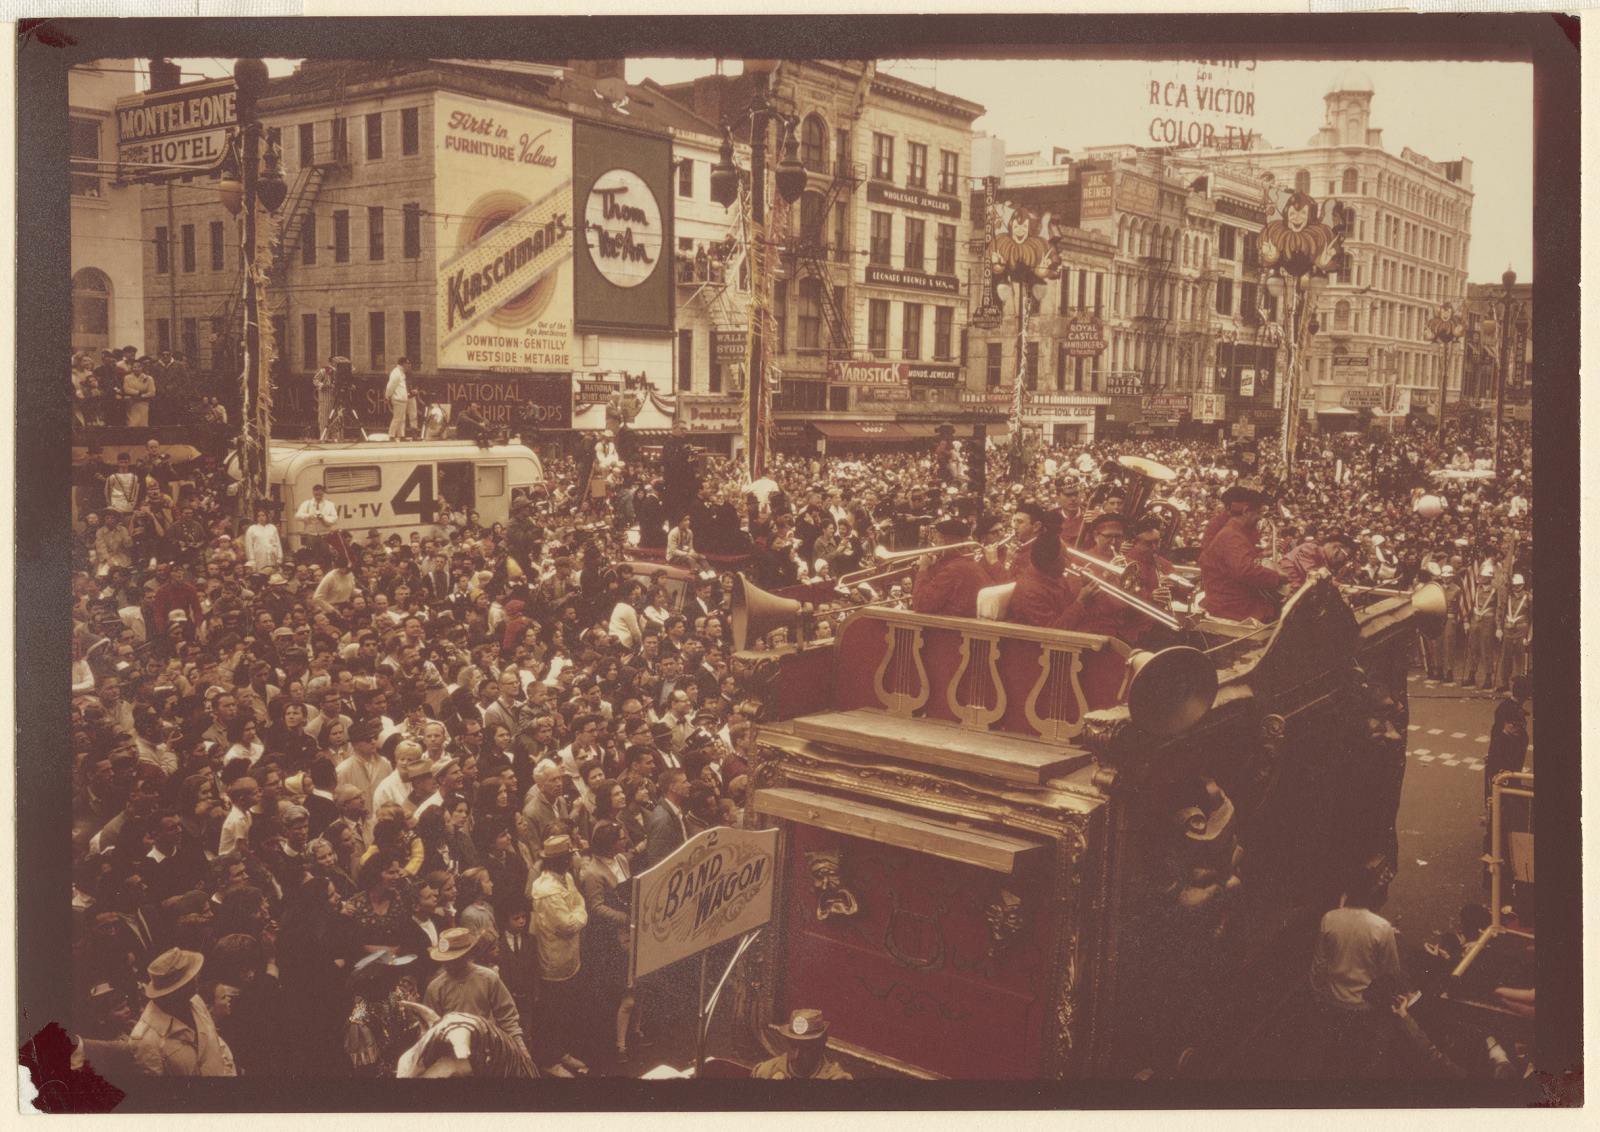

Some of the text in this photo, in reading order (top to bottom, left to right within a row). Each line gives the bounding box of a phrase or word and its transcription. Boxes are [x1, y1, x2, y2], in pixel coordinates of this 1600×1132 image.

[1149, 80, 1256, 117] RCA VICTOR
[120, 92, 238, 140] MONTELEONE
[447, 110, 508, 138] First in
[1149, 117, 1253, 151] COLOR TV
[151, 136, 218, 164] HOTEL
[445, 129, 558, 168] FURNITURE Values
[592, 186, 650, 227] Thom
[883, 190, 950, 211] WHOLESALE JEWELERS
[592, 223, 654, 265] McAn
[872, 271, 901, 283] LEONARD
[1068, 332, 1099, 341] CASTLE
[1070, 324, 1098, 333] ROYAL
[466, 335, 568, 351] DOWNTOWN GENTILLY
[466, 350, 570, 366] WESTSIDE METAIRIE
[840, 362, 901, 383] YARDSTICK
[1106, 378, 1134, 386] RITZ
[448, 383, 524, 402] NATIONAL
[1106, 386, 1139, 395] HOTEL
[691, 407, 743, 423] Doubleday
[391, 464, 440, 523] 4
[707, 831, 718, 848] 2
[662, 853, 723, 922] BAND
[694, 857, 767, 931] WAGON
